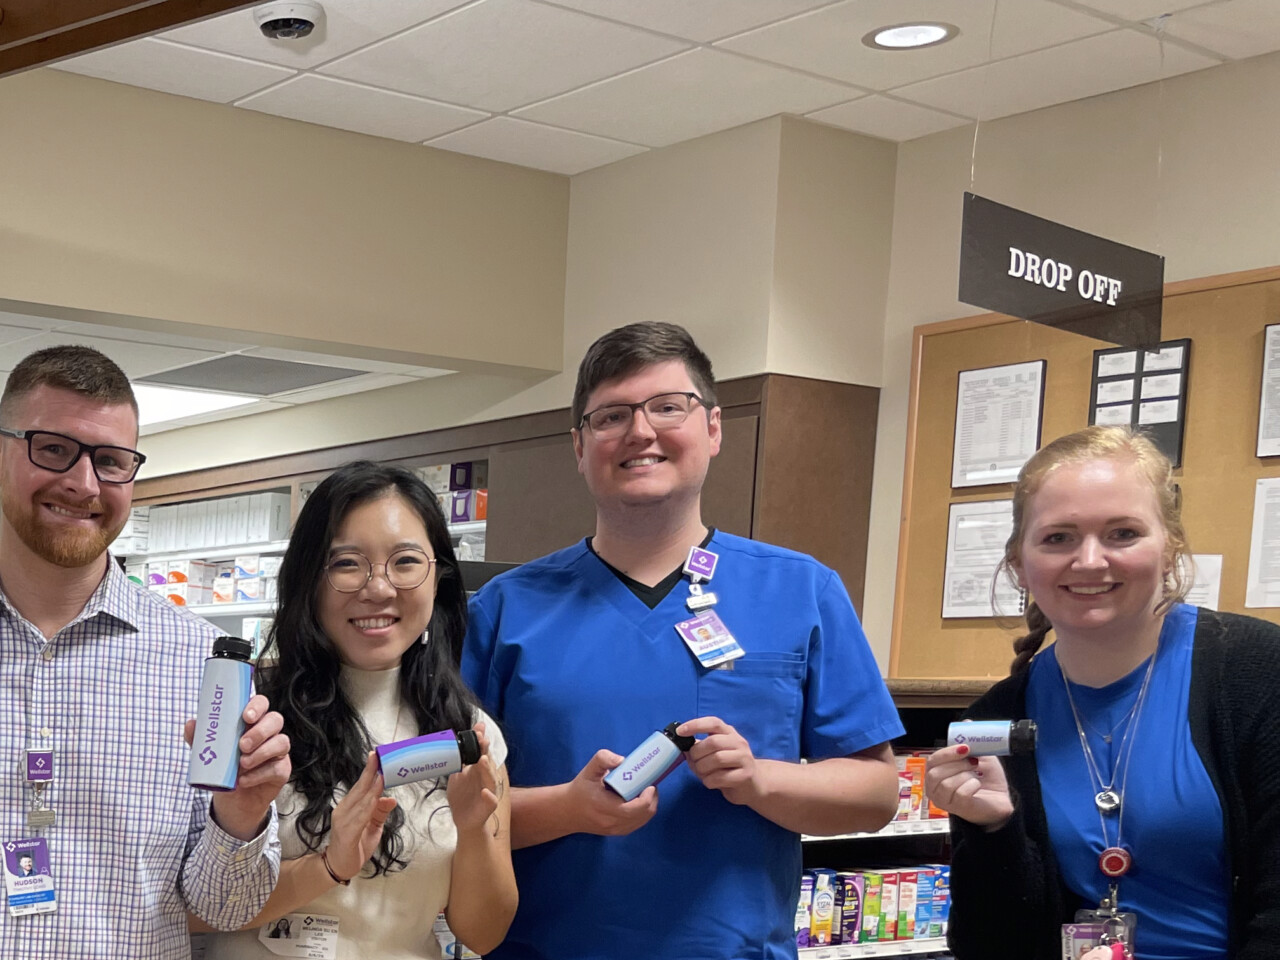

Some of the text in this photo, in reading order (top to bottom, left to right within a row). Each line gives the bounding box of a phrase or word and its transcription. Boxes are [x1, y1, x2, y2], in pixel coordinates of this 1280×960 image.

[1007, 247, 1122, 306] DROP OFF
[205, 684, 224, 743] Wellstar
[967, 735, 1004, 744] Wellstar
[632, 746, 661, 773] Wellstar
[410, 760, 448, 775] Wellstar
[17, 841, 41, 849] Wellstar
[14, 877, 44, 887] HUDSON
